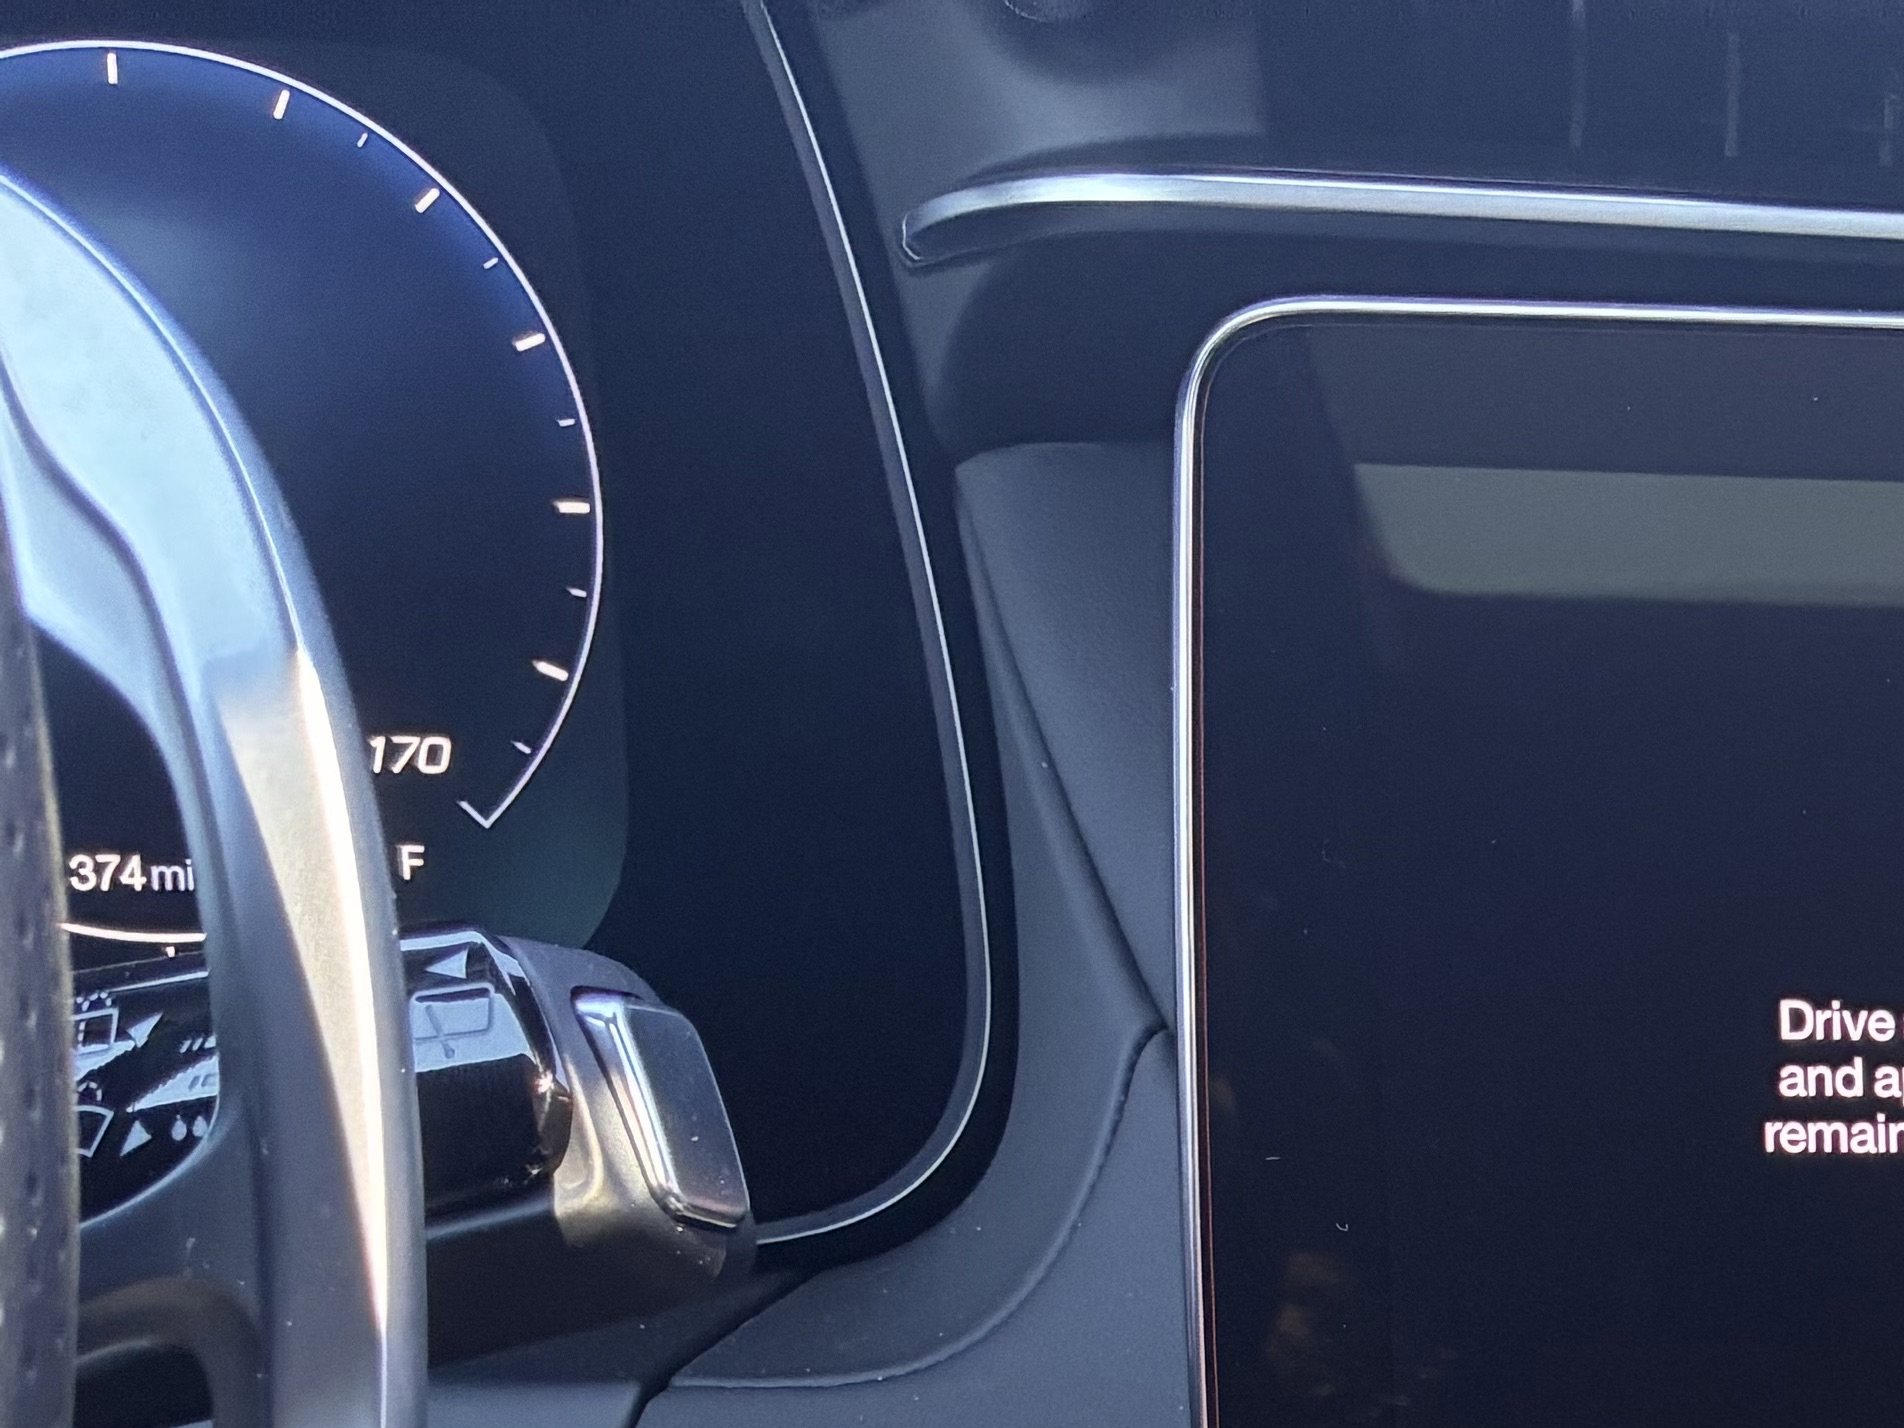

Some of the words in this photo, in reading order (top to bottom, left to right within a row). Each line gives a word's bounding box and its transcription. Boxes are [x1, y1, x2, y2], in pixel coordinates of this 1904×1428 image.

[367, 735, 452, 775] 170
[1779, 998, 1896, 1043] Drive
[1778, 1054, 1864, 1098] and
